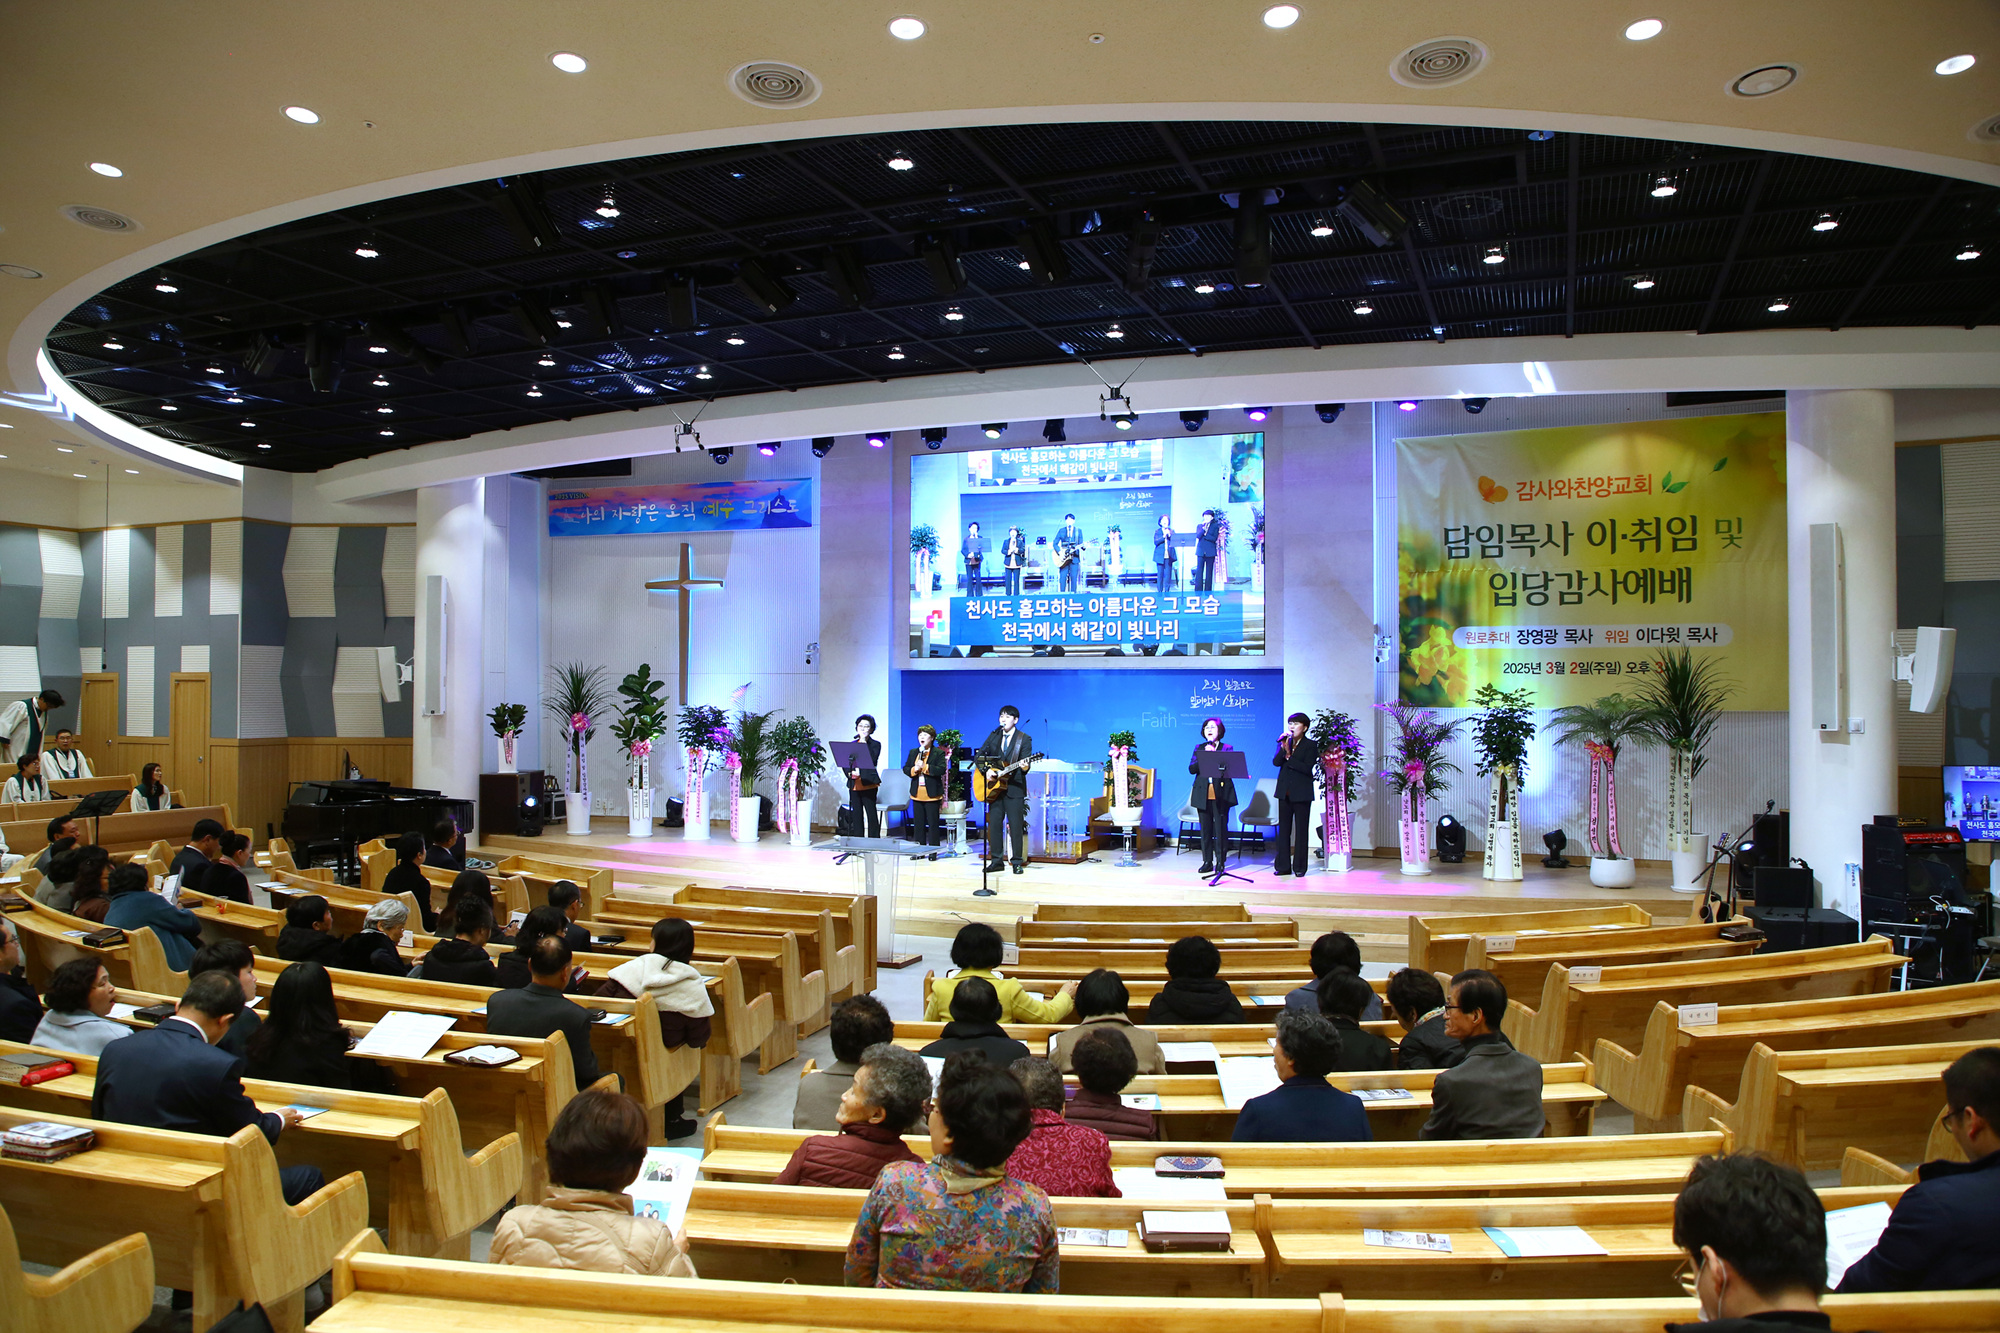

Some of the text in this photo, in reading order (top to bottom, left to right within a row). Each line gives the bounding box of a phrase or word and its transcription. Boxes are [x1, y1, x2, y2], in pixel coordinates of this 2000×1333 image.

[1515, 473, 1654, 502] 감사와찬양교회
[581, 498, 800, 525] 나의 자랑은 오직 예수 그리스도
[1444, 514, 1744, 560] 담임목사 이·취임 및
[1488, 566, 1692, 607] 입당감사예배
[966, 594, 1220, 620] 천사도 흠모하는 아름다운 그 모습
[1002, 616, 1180, 642] 천국에서 해같이 빛나리
[1464, 626, 1718, 646] 원로추대 장영광 목사 위임 이다윗 목사
[1502, 661, 1542, 676] 2025년
[1546, 660, 1566, 675] 3월
[1570, 660, 1622, 676] 2일(주일)
[1625, 660, 1650, 675] 오후
[1141, 712, 1177, 728] Faith
[1966, 821, 1986, 830] 천사도
[1512, 832, 1521, 868] 축하드립니다
